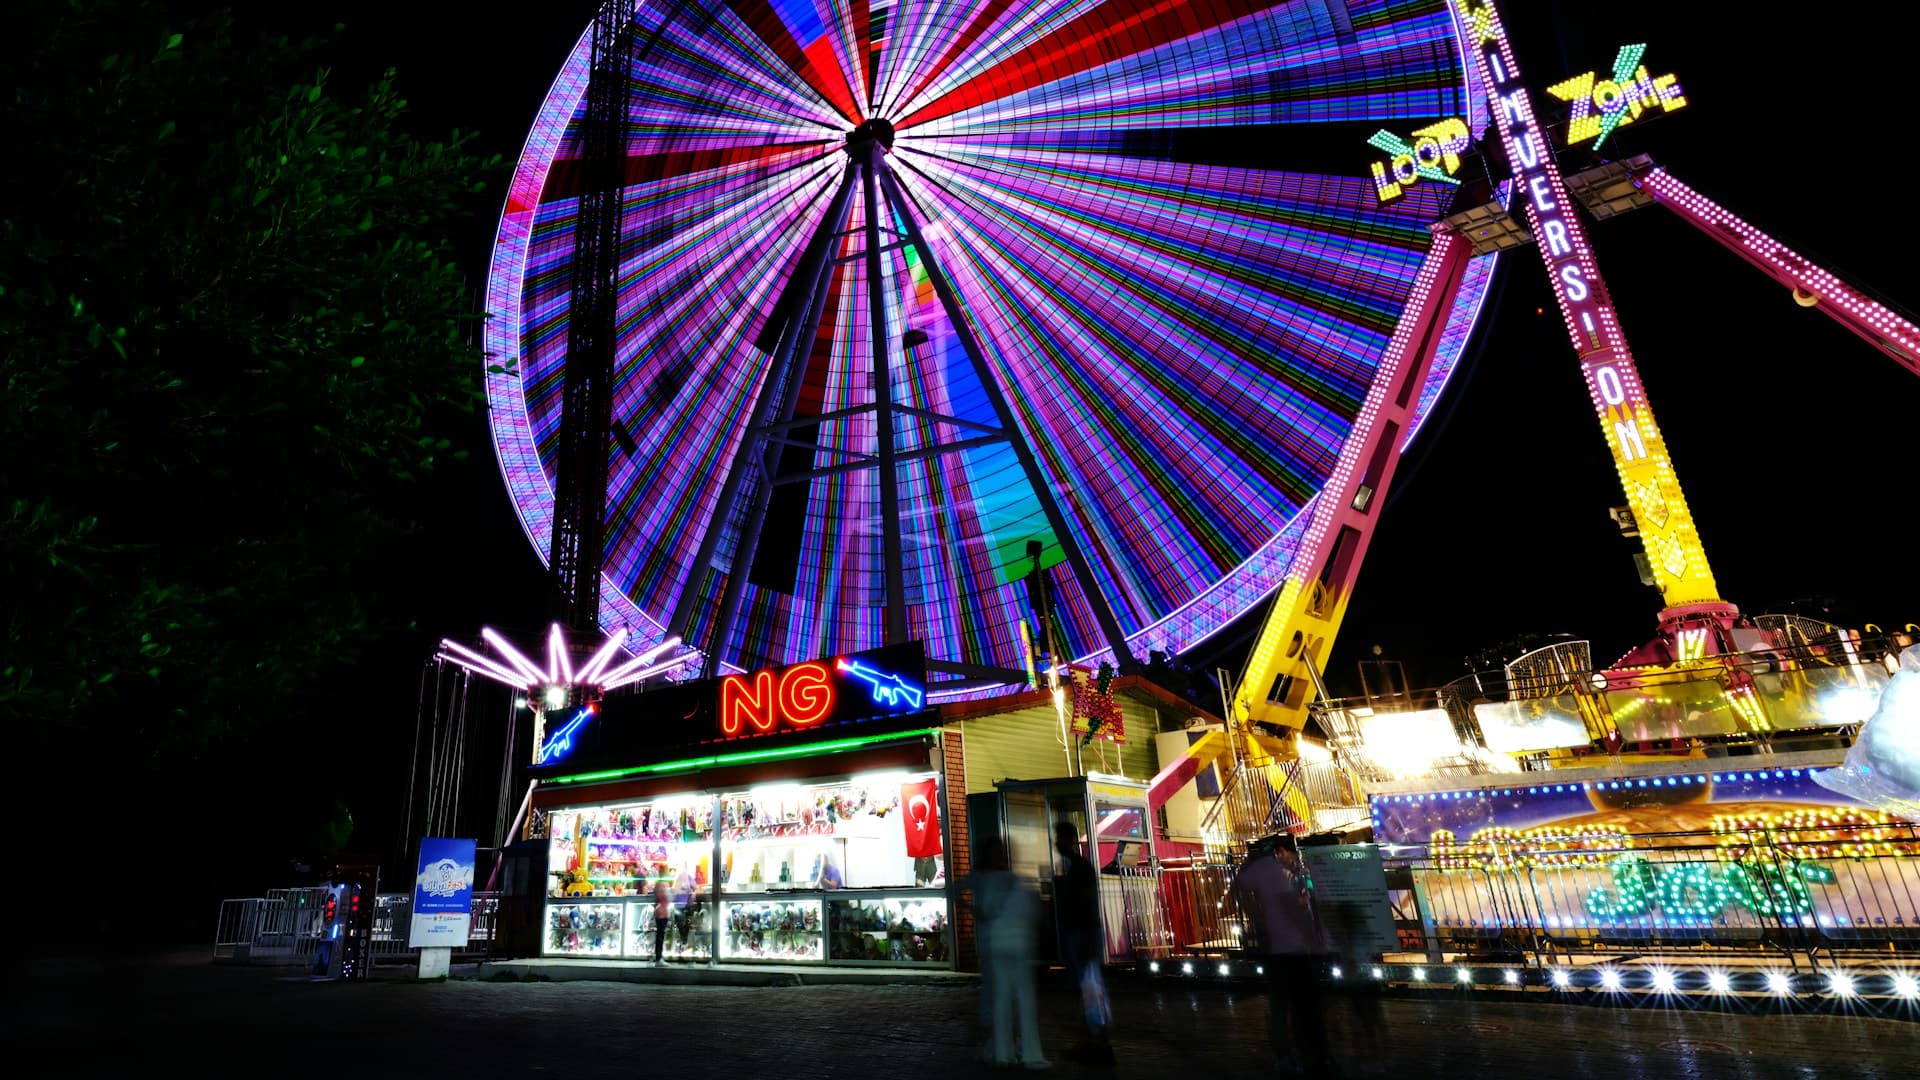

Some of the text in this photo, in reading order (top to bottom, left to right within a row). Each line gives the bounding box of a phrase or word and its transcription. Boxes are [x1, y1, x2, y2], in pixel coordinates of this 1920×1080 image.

[1369, 64, 1688, 203] LOOP ZONE
[1490, 53, 1646, 461] INVERSION
[721, 661, 832, 735] NG
[1430, 806, 1920, 872] LOOP ZON
